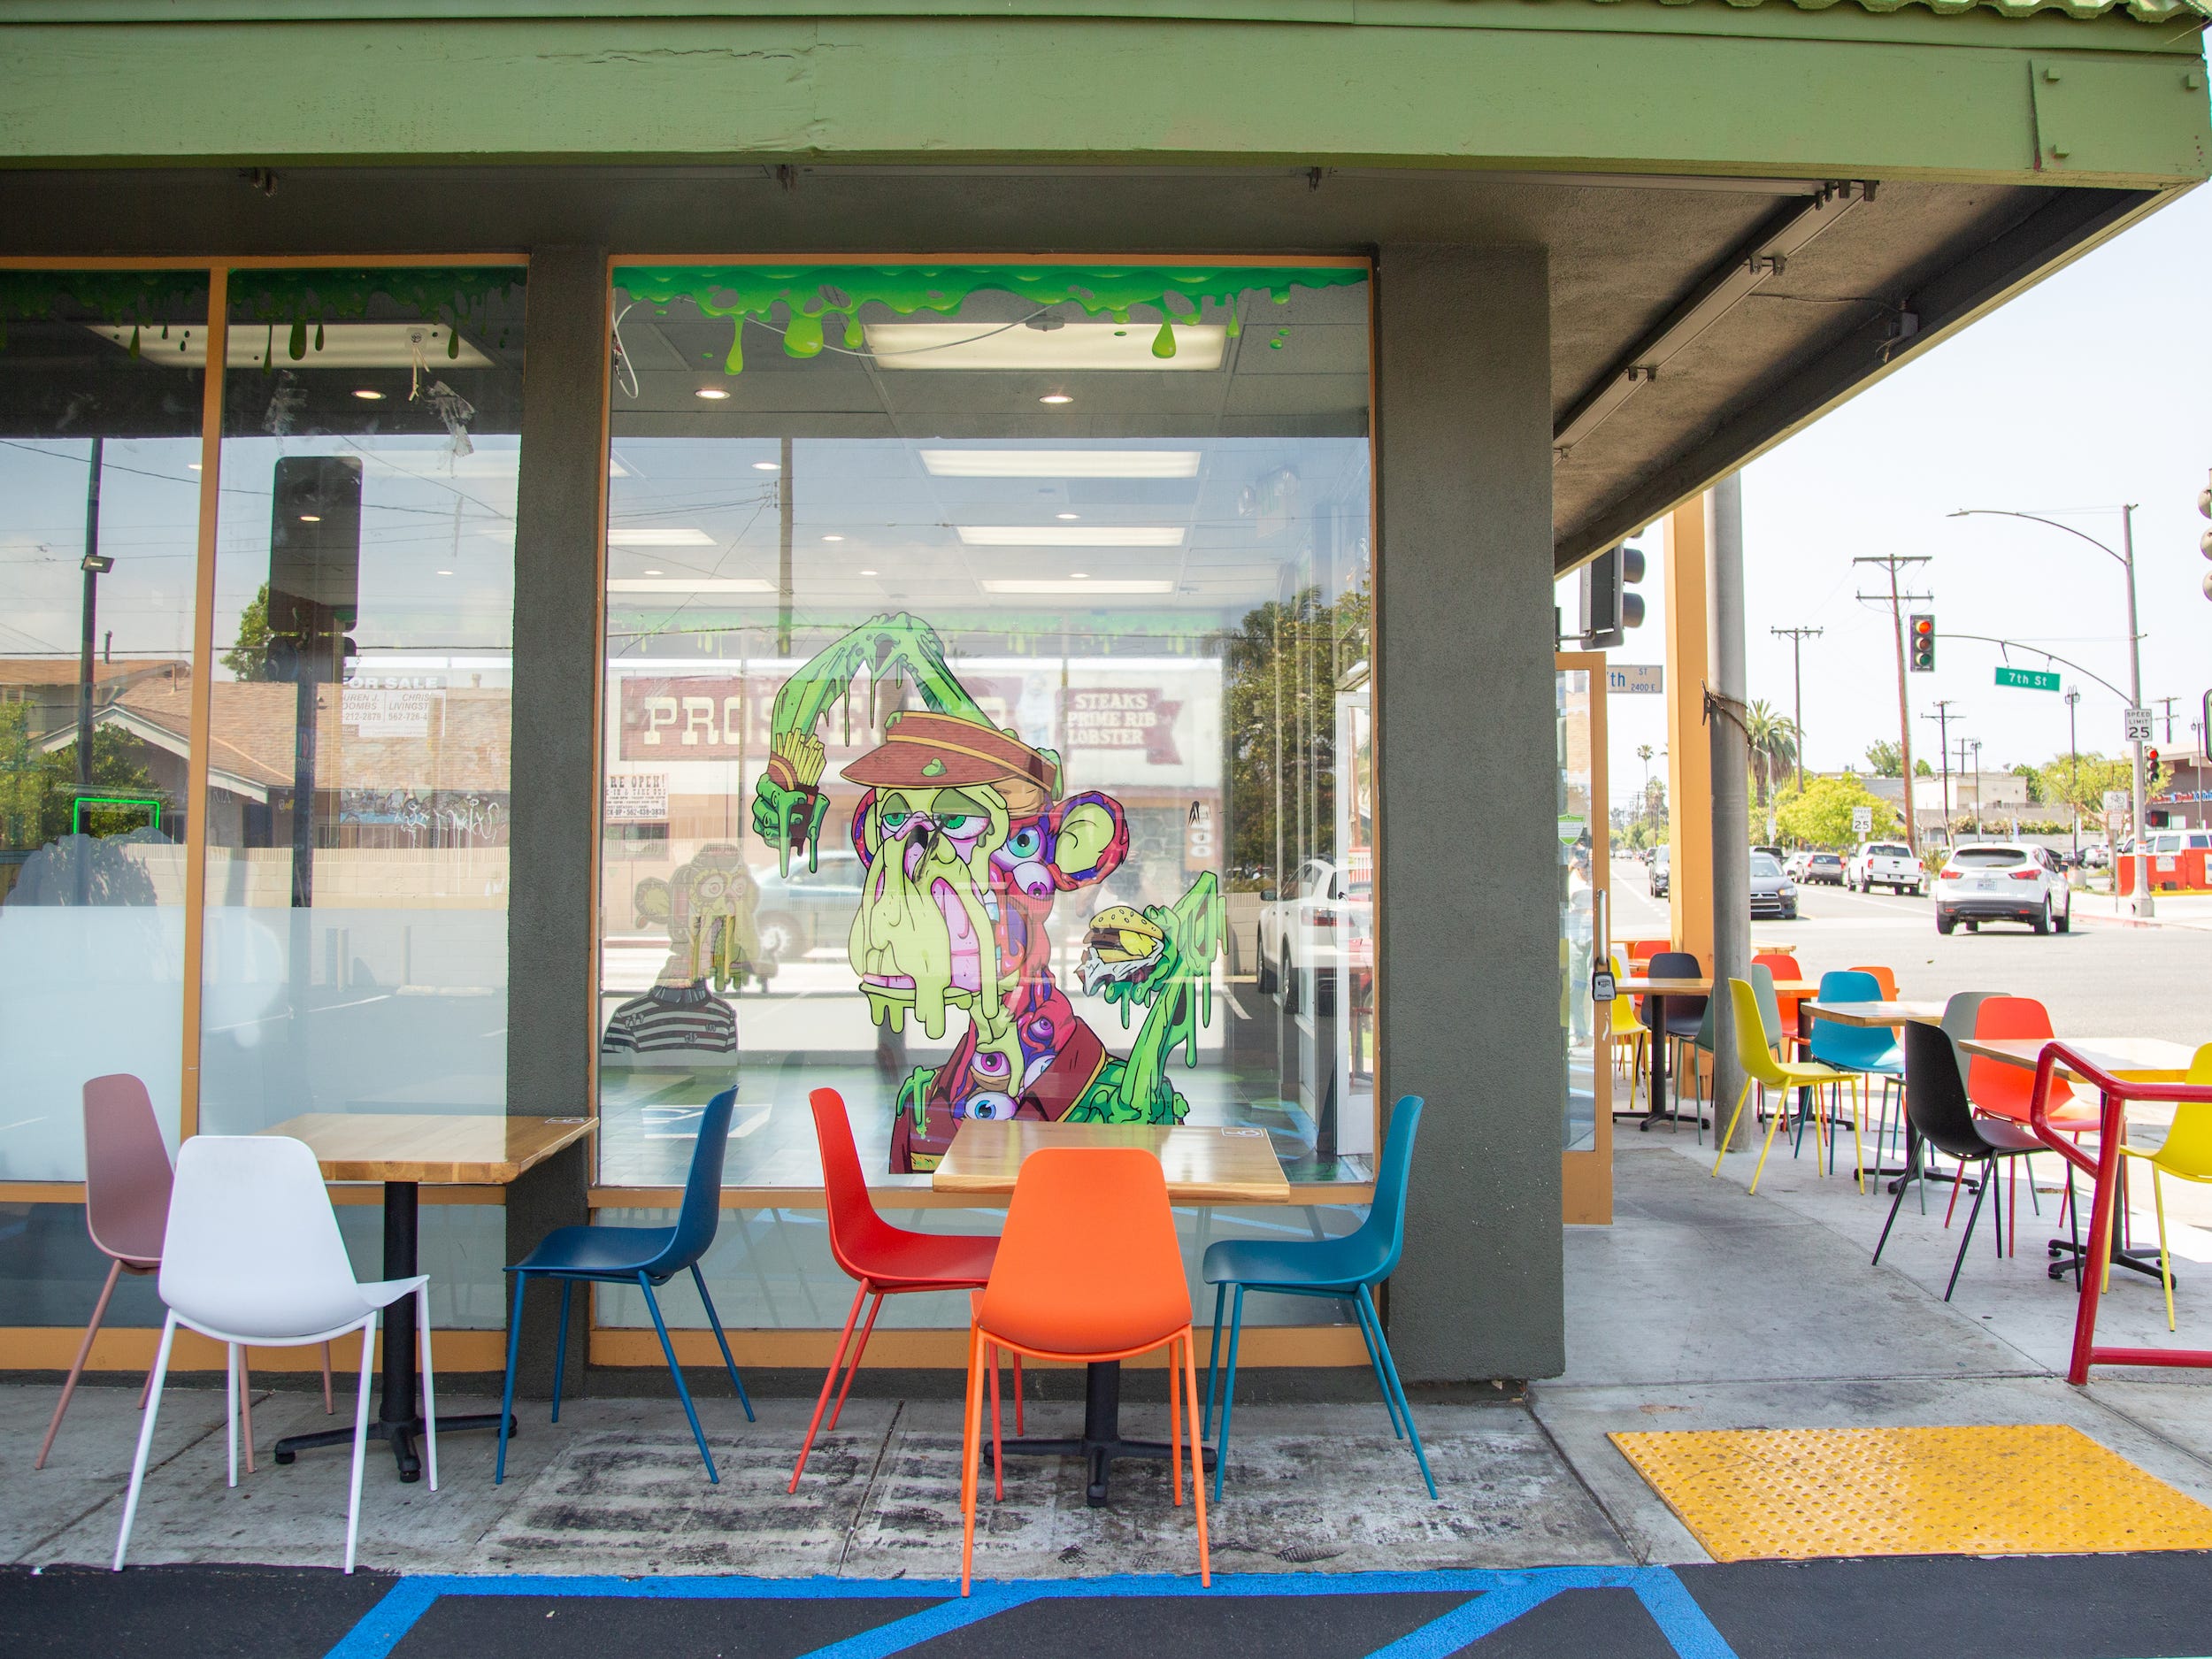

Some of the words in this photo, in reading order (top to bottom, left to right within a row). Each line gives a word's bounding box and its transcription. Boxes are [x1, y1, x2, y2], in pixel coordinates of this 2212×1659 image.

[385, 677, 438, 688] SALE
[1607, 672, 1625, 687] th
[2008, 672, 2029, 685] 7th
[2034, 675, 2047, 687] St
[1075, 693, 1148, 709] STEAKS
[1067, 711, 1121, 726] PRIME
[1125, 711, 1157, 726] RIB
[1067, 728, 1146, 744] LOBSTER
[2129, 726, 2150, 738] 25
[632, 774, 664, 787] OPEN!
[1855, 820, 1870, 830] 25
